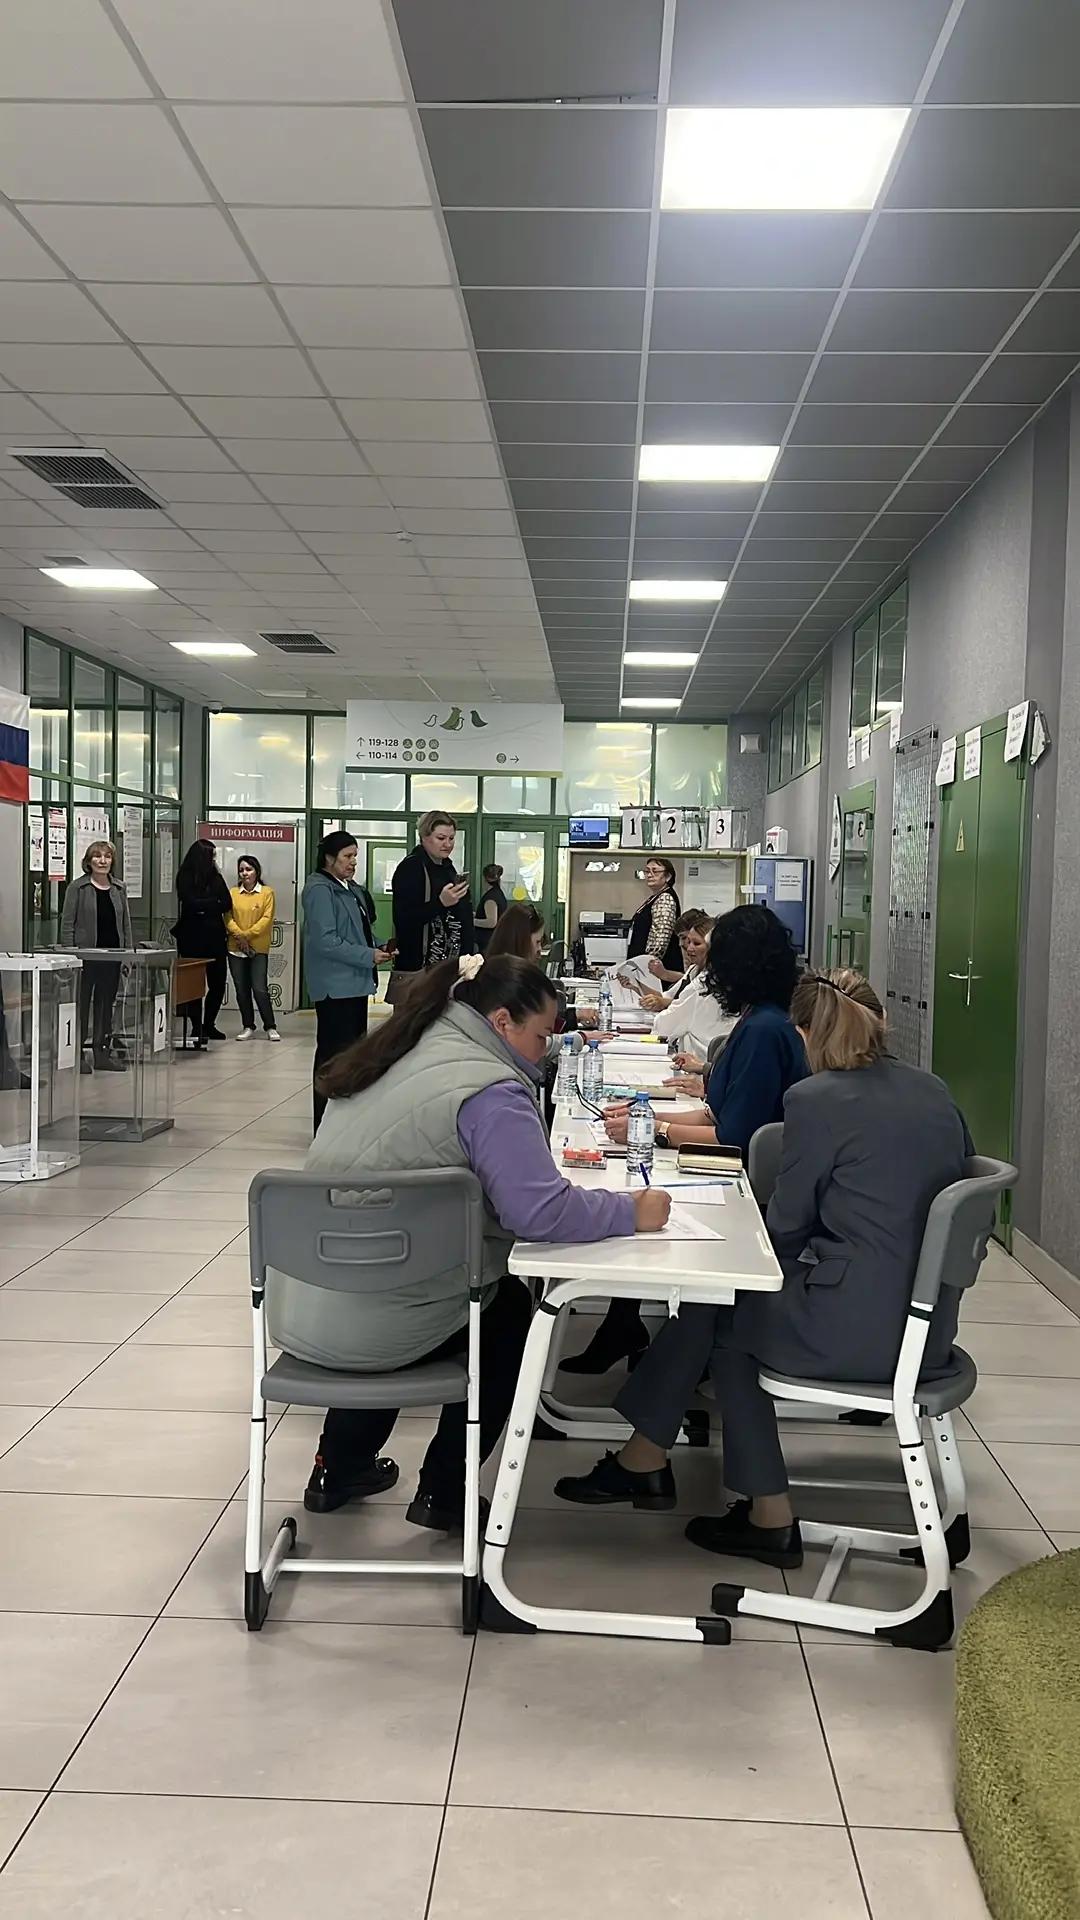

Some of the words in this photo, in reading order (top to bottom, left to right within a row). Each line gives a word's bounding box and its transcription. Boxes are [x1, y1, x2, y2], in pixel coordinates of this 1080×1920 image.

[368, 738, 399, 747] 119-128
[368, 751, 397, 759] 110-114
[630, 818, 636, 835] 1
[666, 816, 676, 834] 2
[715, 818, 725, 834] 3
[211, 828, 284, 839] ИНФОРМАЦИЯ
[157, 1008, 163, 1034] 2
[65, 1019, 72, 1047] 1
